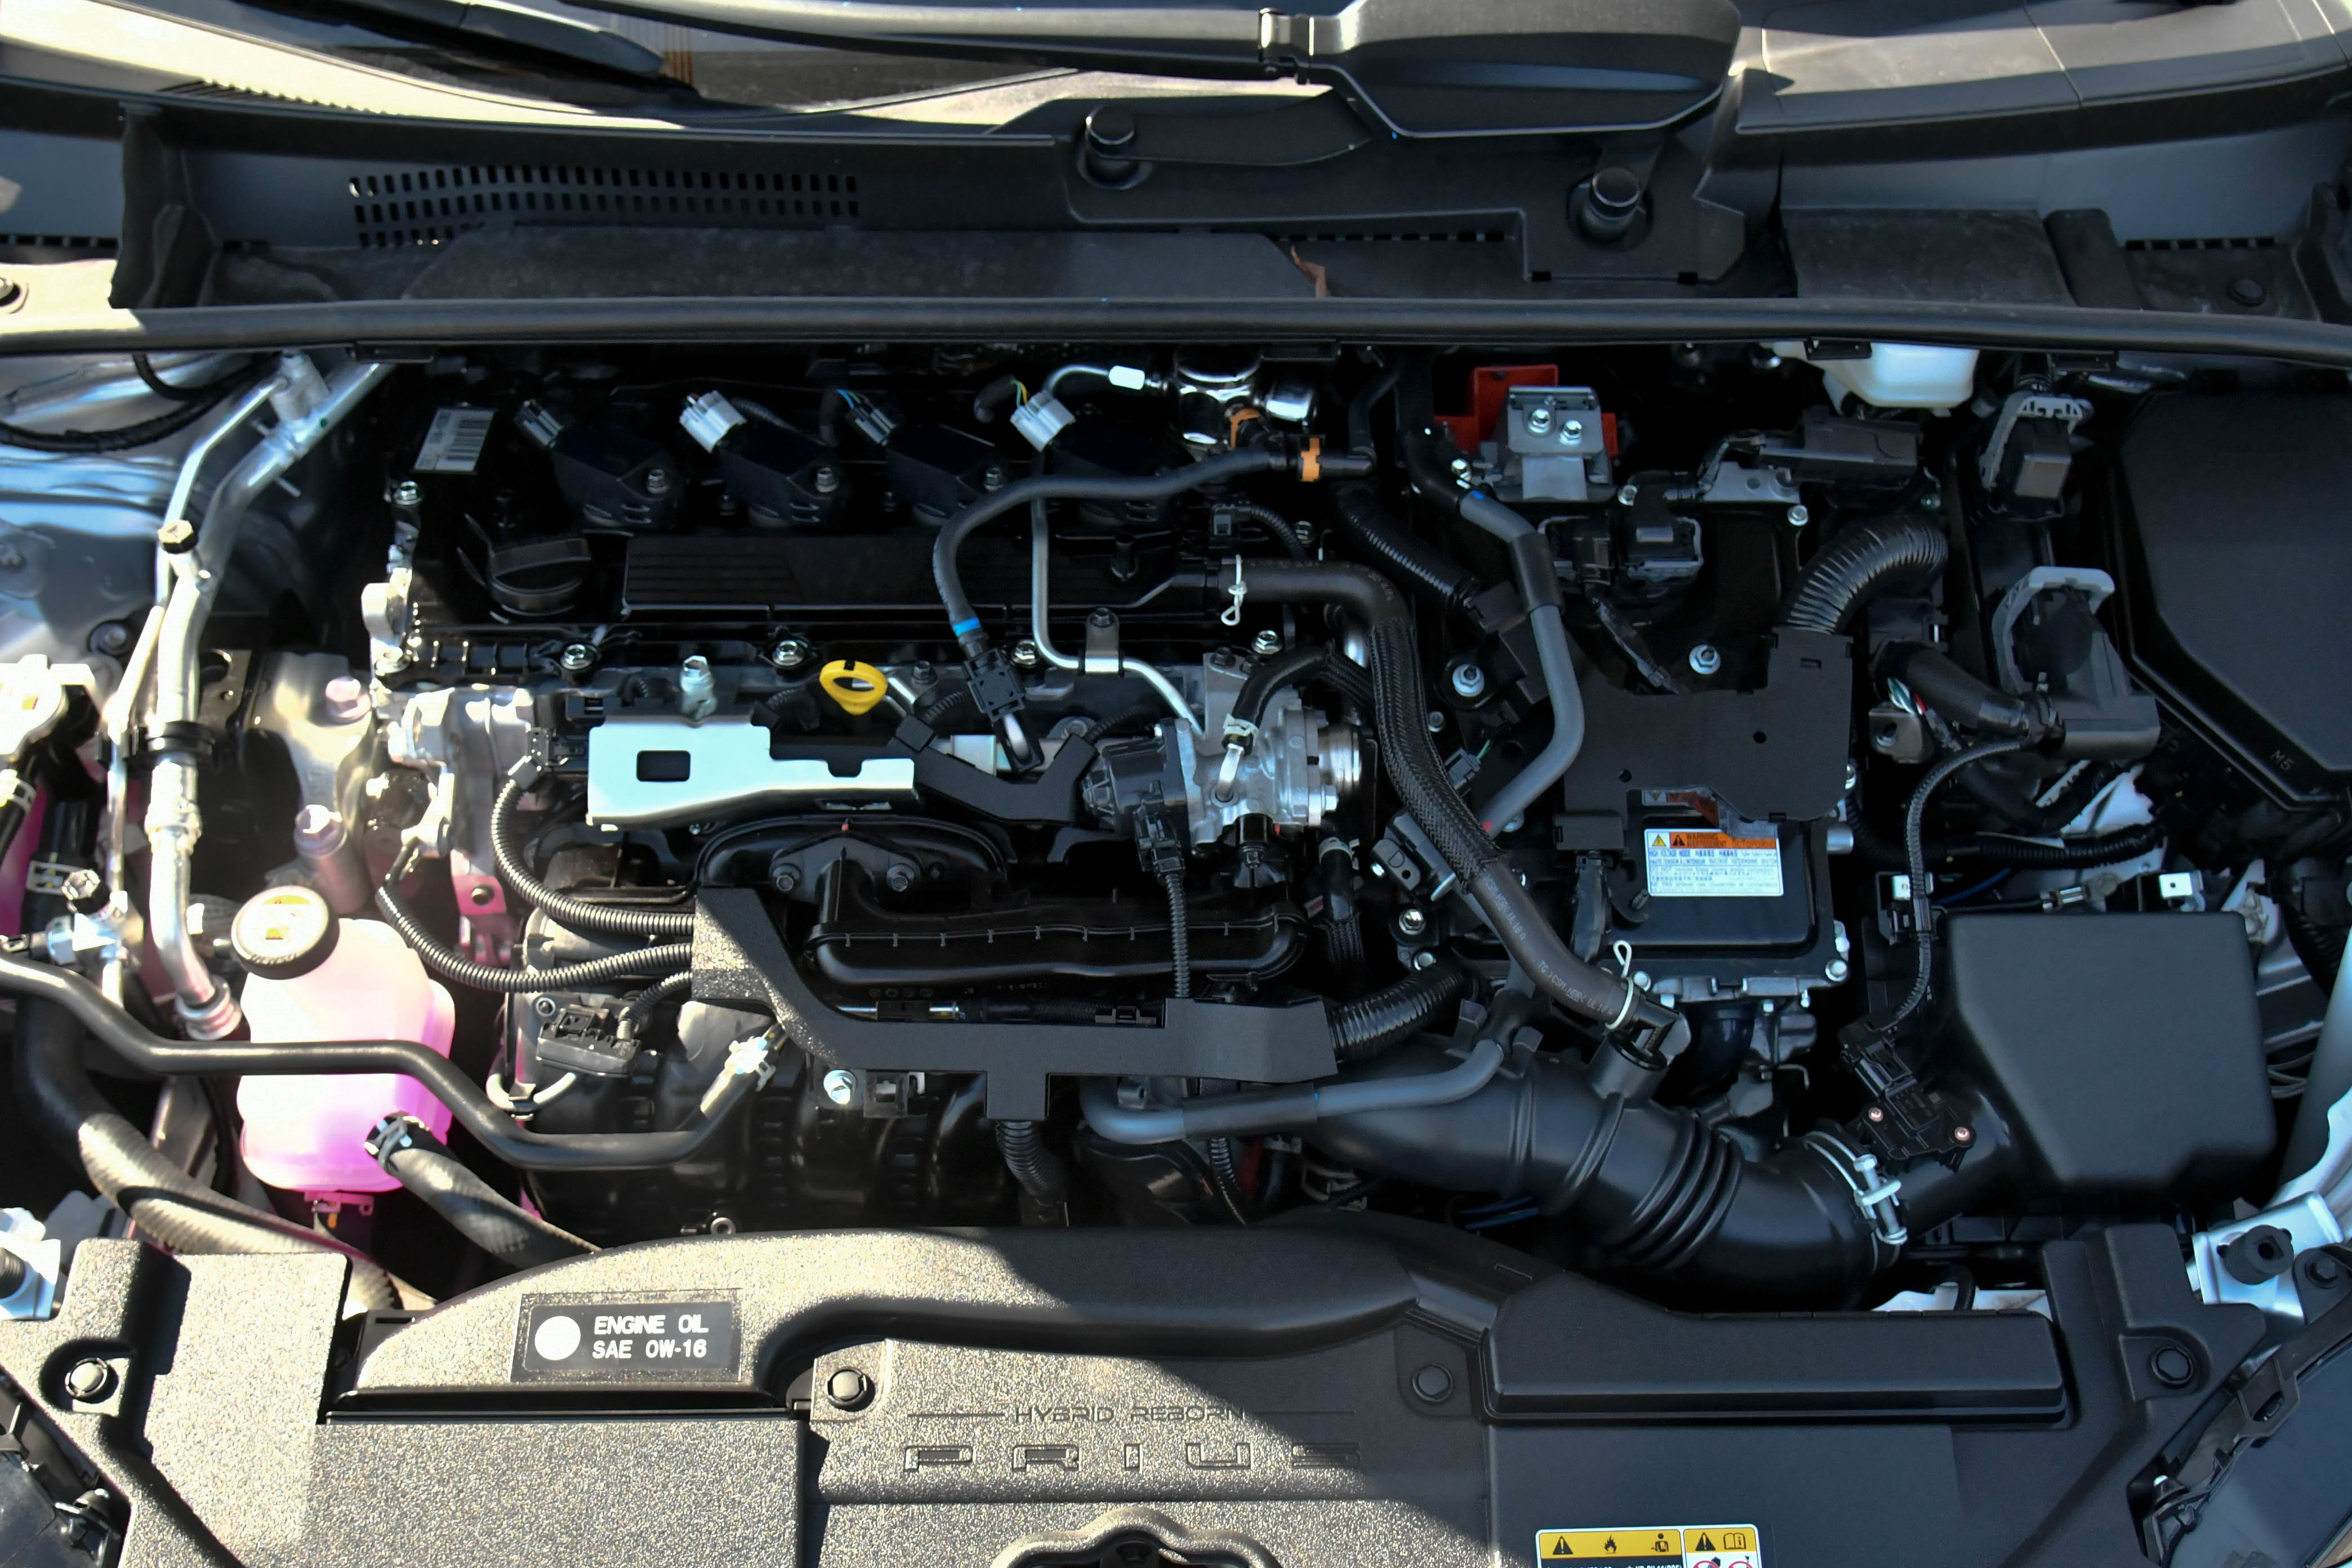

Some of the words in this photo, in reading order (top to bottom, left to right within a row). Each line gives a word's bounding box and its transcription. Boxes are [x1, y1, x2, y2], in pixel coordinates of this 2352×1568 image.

[594, 1315, 666, 1335] ENGINE
[678, 1314, 709, 1334] OIL
[592, 1339, 632, 1358] SAE
[645, 1339, 707, 1358] 0W-16
[1015, 1407, 1115, 1423] HYBRID
[1130, 1406, 1246, 1422] REBORN
[905, 1443, 1361, 1471] PRIUS
